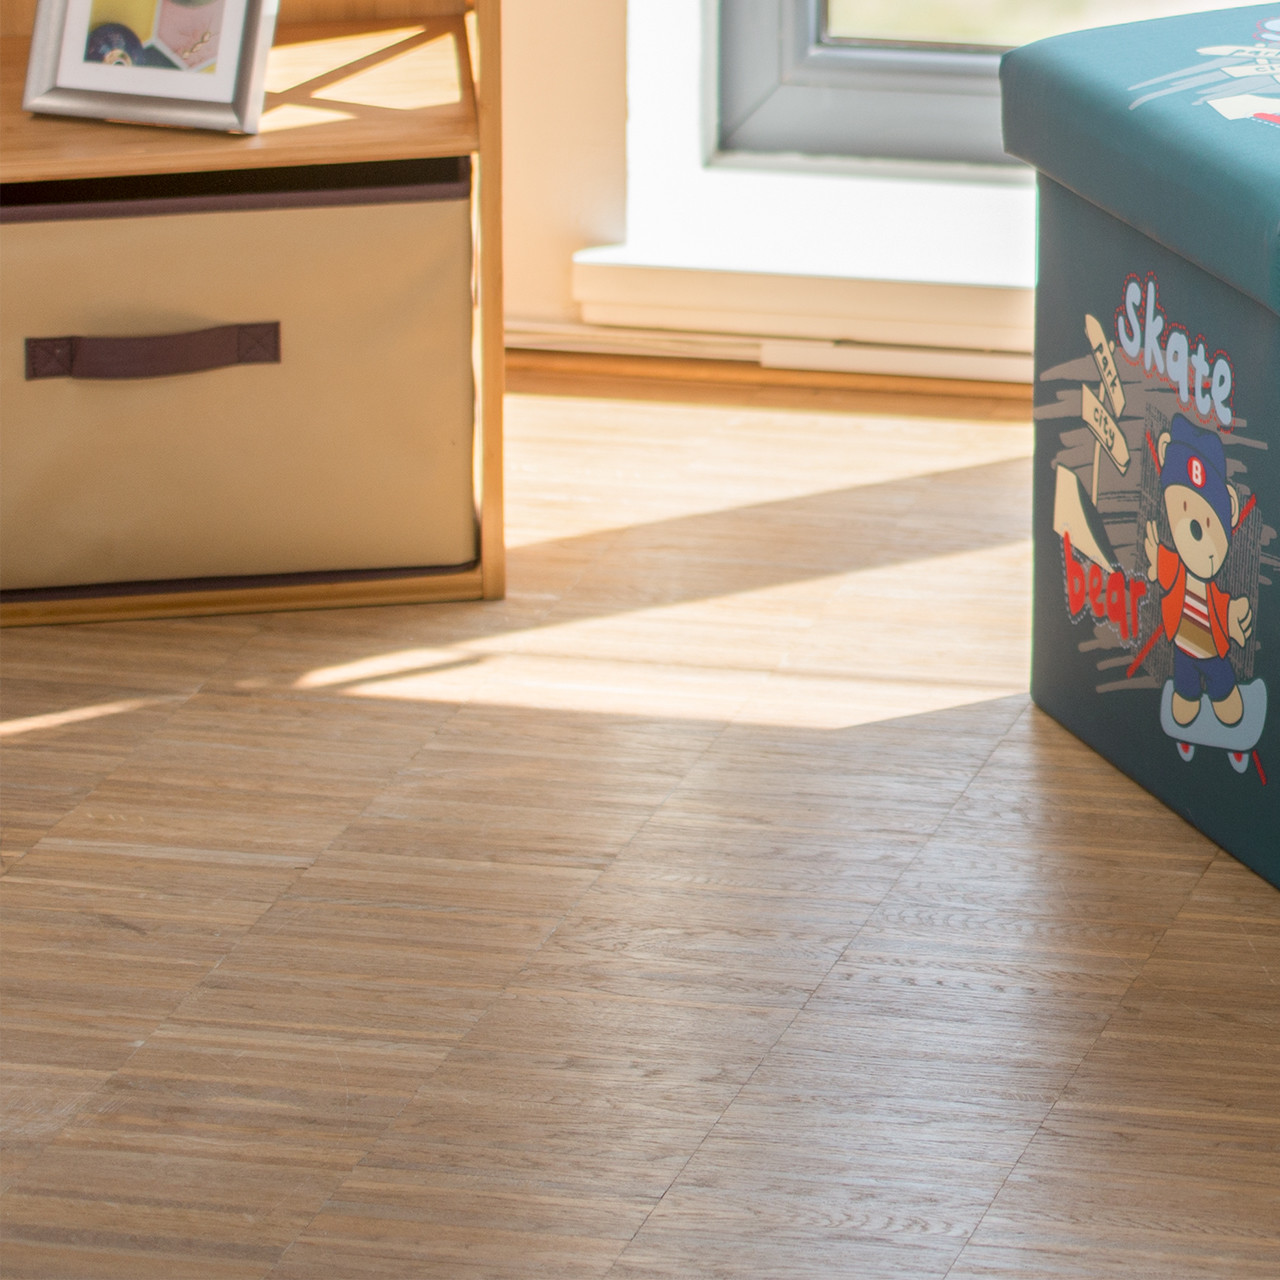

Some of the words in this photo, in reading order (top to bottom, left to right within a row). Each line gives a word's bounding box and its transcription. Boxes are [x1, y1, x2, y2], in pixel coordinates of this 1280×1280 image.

[1093, 342, 1118, 394] park
[1094, 407, 1115, 452] city
[1190, 459, 1203, 487] B
[1064, 531, 1147, 640] bear
